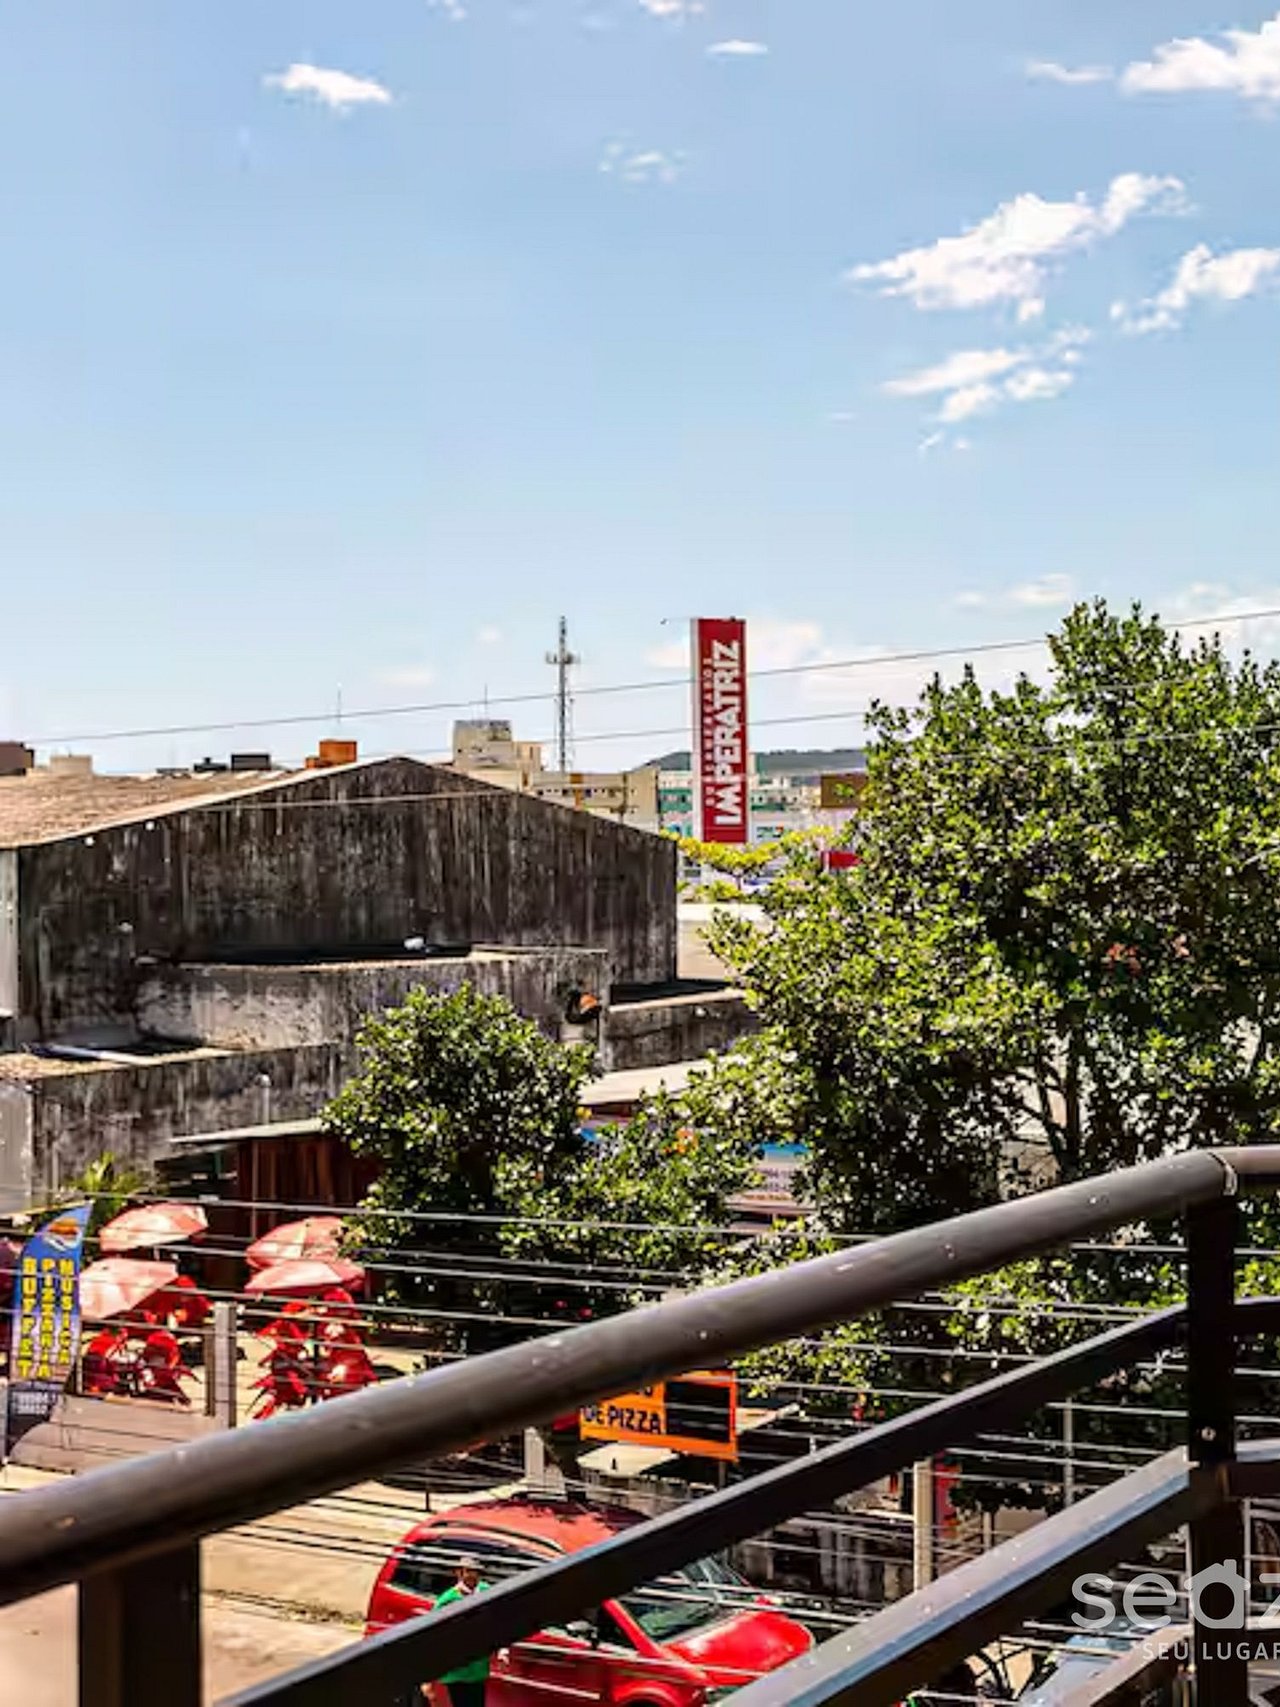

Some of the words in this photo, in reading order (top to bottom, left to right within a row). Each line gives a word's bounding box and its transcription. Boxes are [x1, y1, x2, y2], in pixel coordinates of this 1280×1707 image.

[713, 639, 742, 825] IMPERATRIZ
[17, 1257, 37, 1378] BUFFET
[607, 1405, 662, 1435] PIZZA
